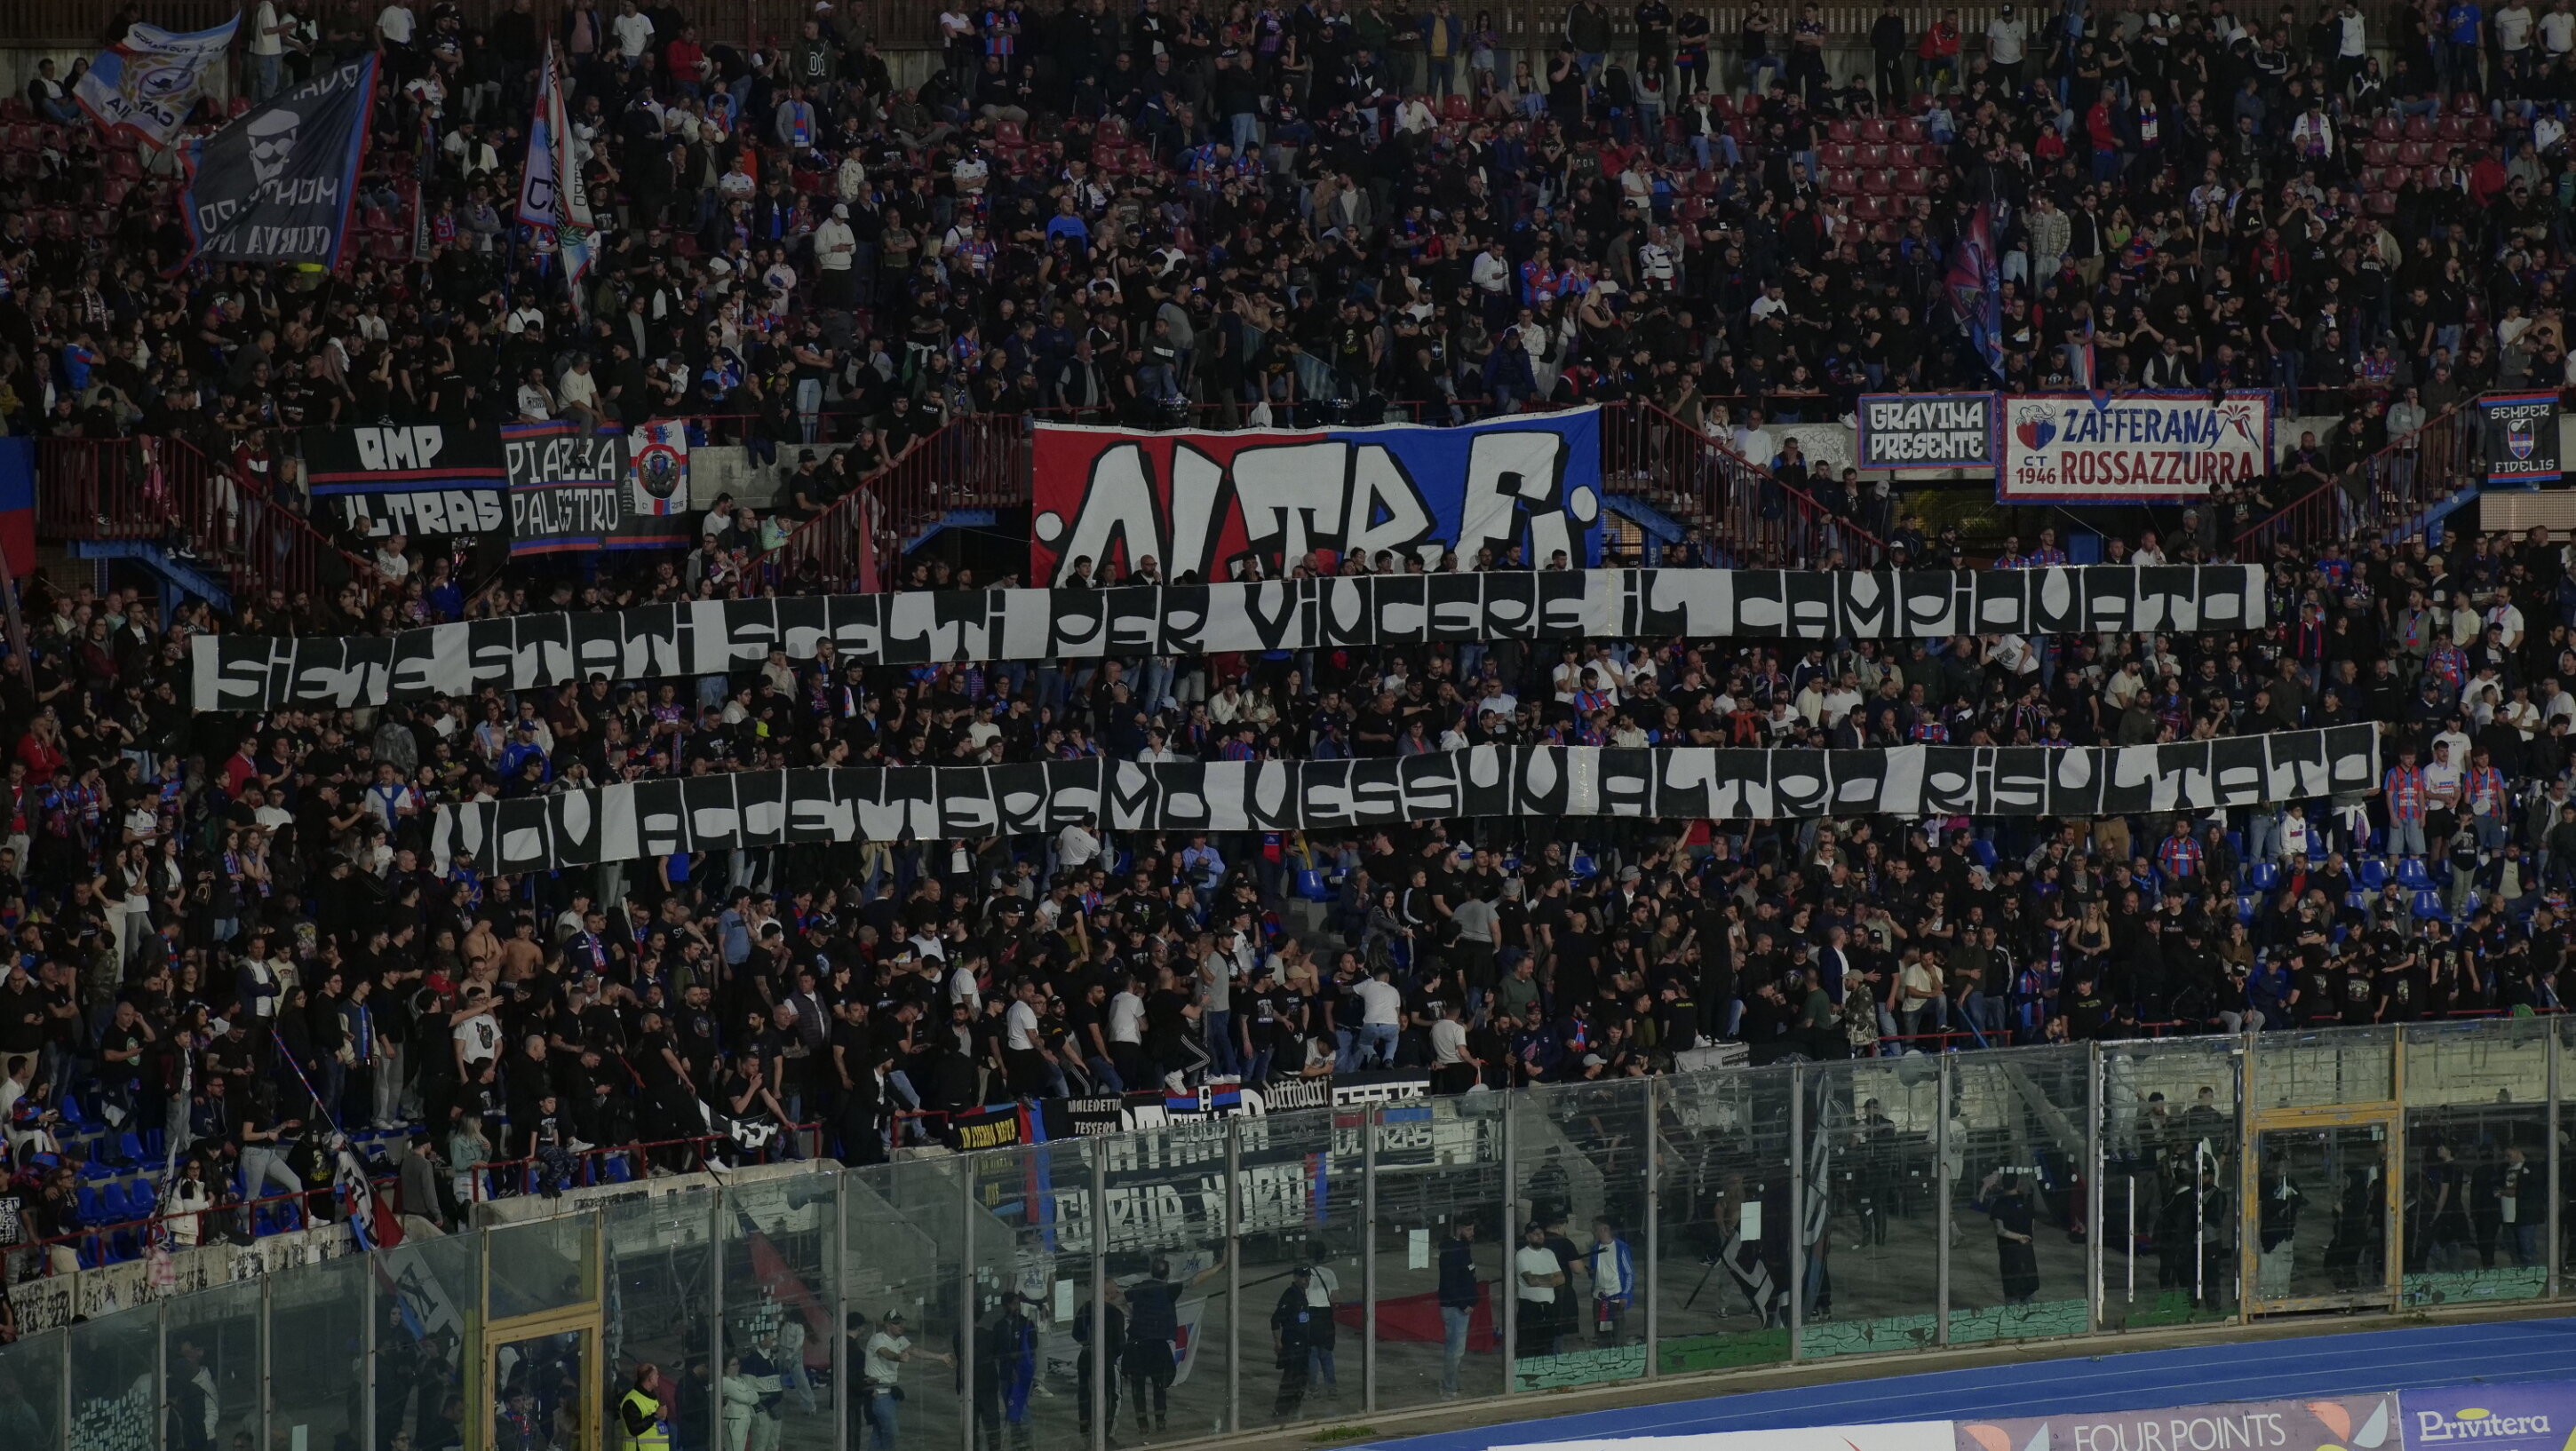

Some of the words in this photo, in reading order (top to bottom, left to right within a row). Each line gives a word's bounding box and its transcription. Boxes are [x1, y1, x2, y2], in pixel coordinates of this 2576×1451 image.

[1870, 402, 1984, 431] GRAVINA
[2061, 408, 2220, 442] ZAFFERANA
[2490, 404, 2550, 420] SEMPER
[1871, 432, 1984, 460] PRESENTE
[2015, 467, 2056, 485] 1946
[2061, 450, 2256, 485] ROSSAZZURRA
[2494, 458, 2555, 473] FIDELIS
[511, 488, 619, 537] PALESTRO
[1067, 1098, 1122, 1113] MALEDETTA
[1074, 1121, 1117, 1135] TESSERA
[2074, 1421, 2162, 1451] FOUR
[2170, 1413, 2286, 1451] POINTS
[2416, 1410, 2551, 1442] Privitera
